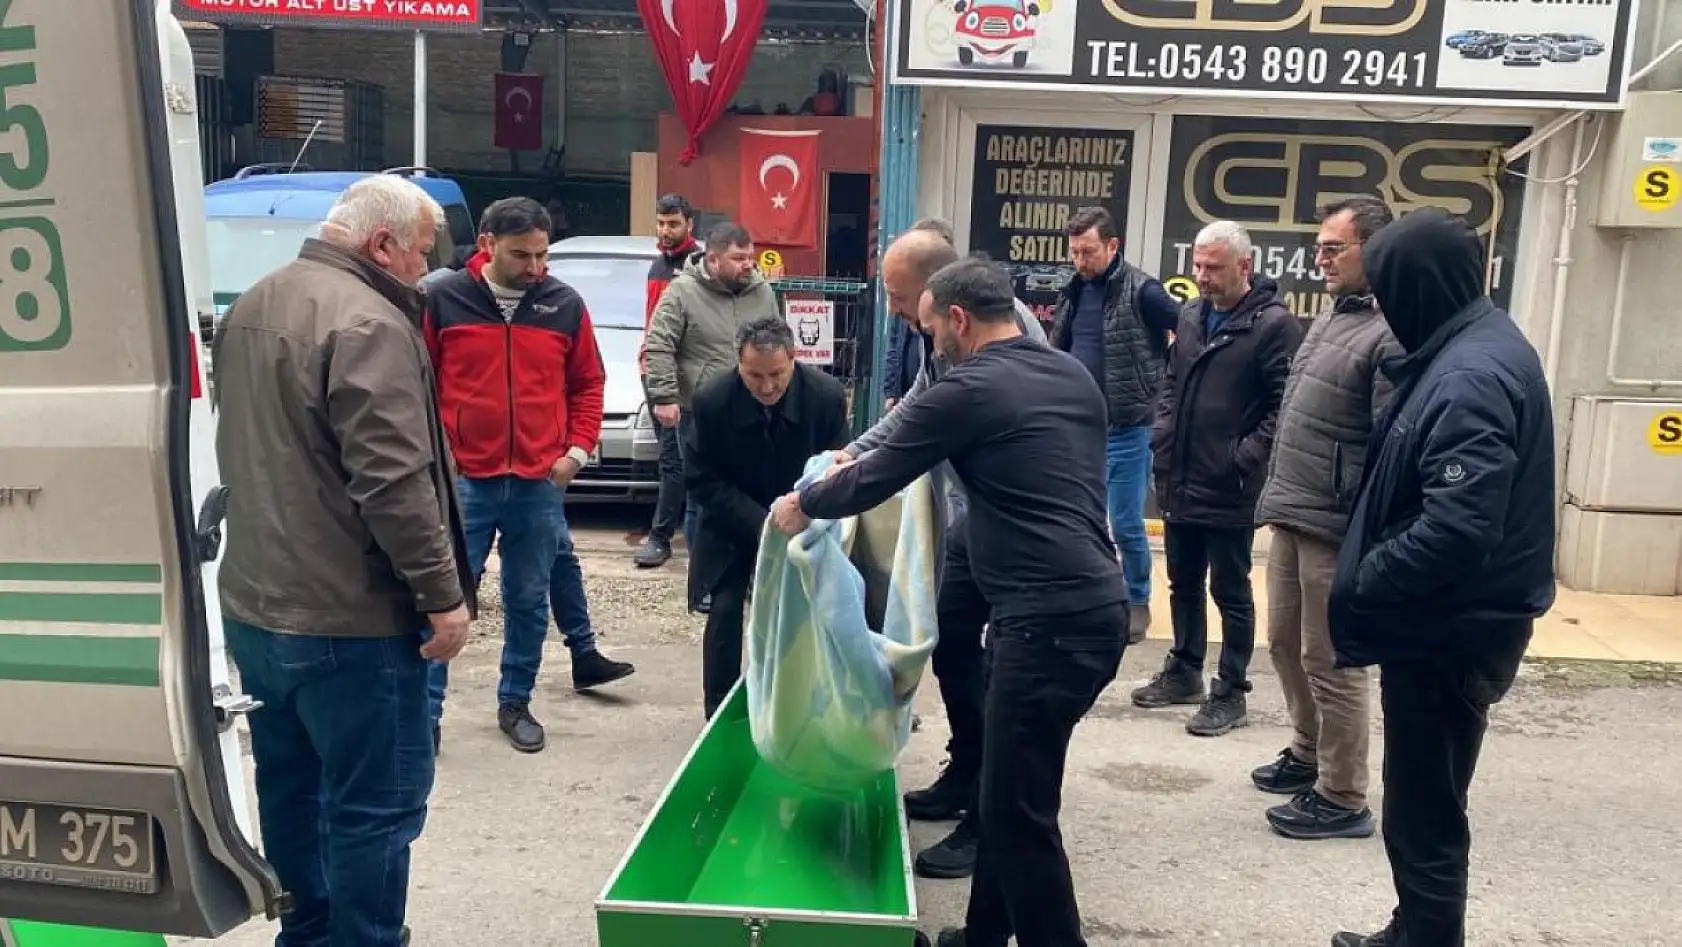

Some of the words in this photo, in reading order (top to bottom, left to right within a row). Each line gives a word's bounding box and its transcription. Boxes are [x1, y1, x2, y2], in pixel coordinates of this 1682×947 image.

[385, 1, 470, 16] YIKAMA
[1087, 40, 1247, 82] TEL:0543
[1261, 46, 1328, 84] 890
[1340, 50, 1427, 88] 2941
[986, 134, 1127, 167] ARAÇLARINIZ
[1645, 171, 1669, 197] S
[1000, 201, 1070, 230] ALINIR
[1009, 235, 1073, 262] SATIL
[1658, 416, 1681, 442] S
[60, 811, 138, 868] 375
